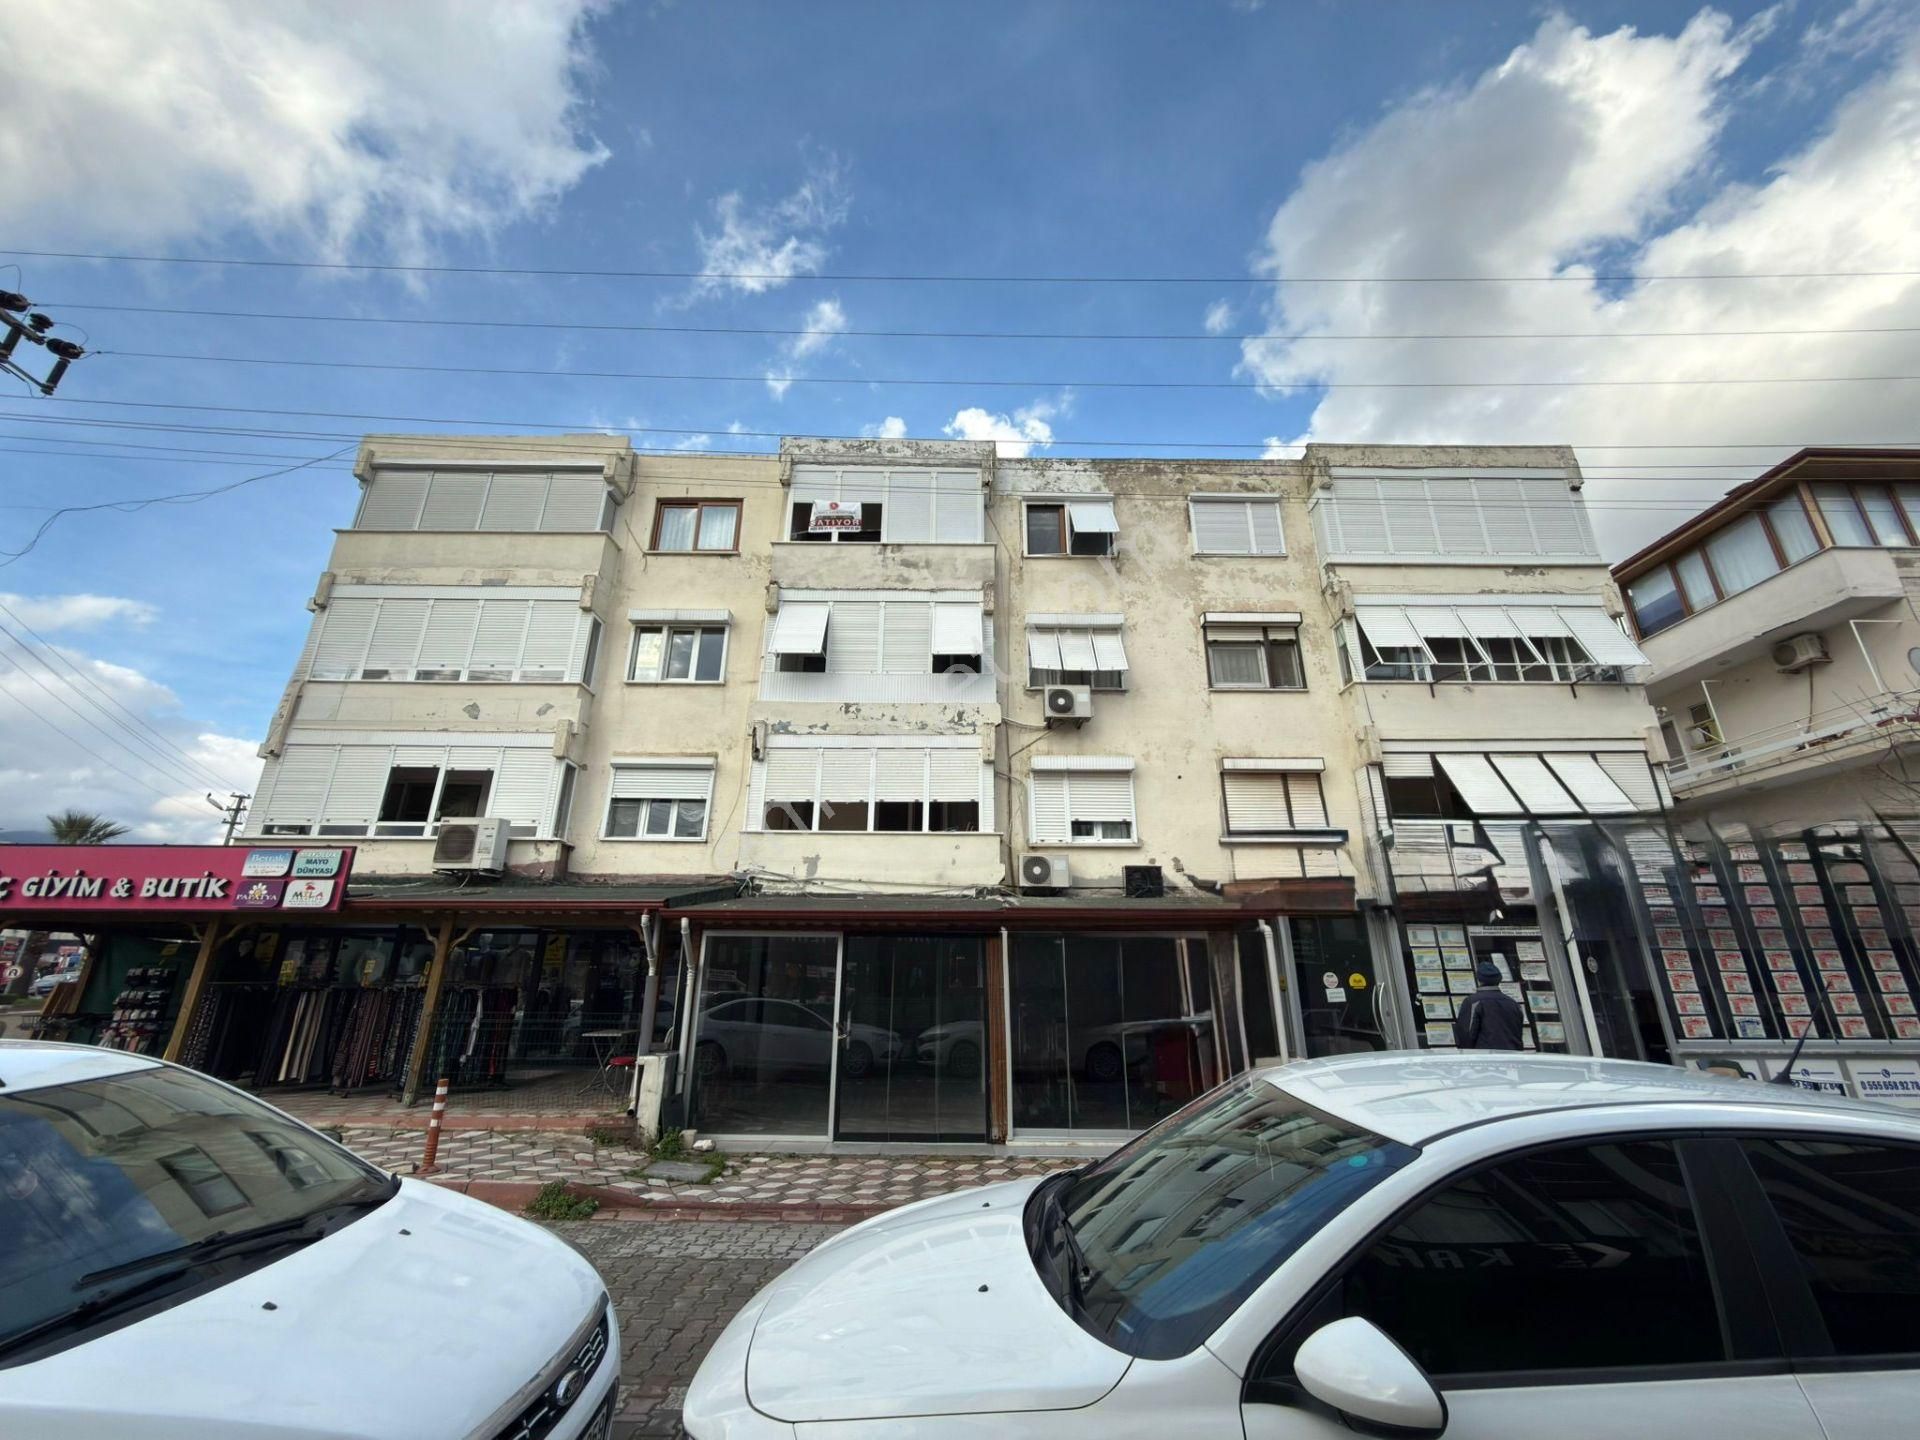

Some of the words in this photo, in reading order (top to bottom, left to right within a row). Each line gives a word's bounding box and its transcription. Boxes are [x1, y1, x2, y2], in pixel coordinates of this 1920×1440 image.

[808, 518, 861, 527] SATIYOR
[21, 869, 102, 898] GİYİM
[109, 877, 131, 898] &
[139, 870, 228, 898] BUTİK
